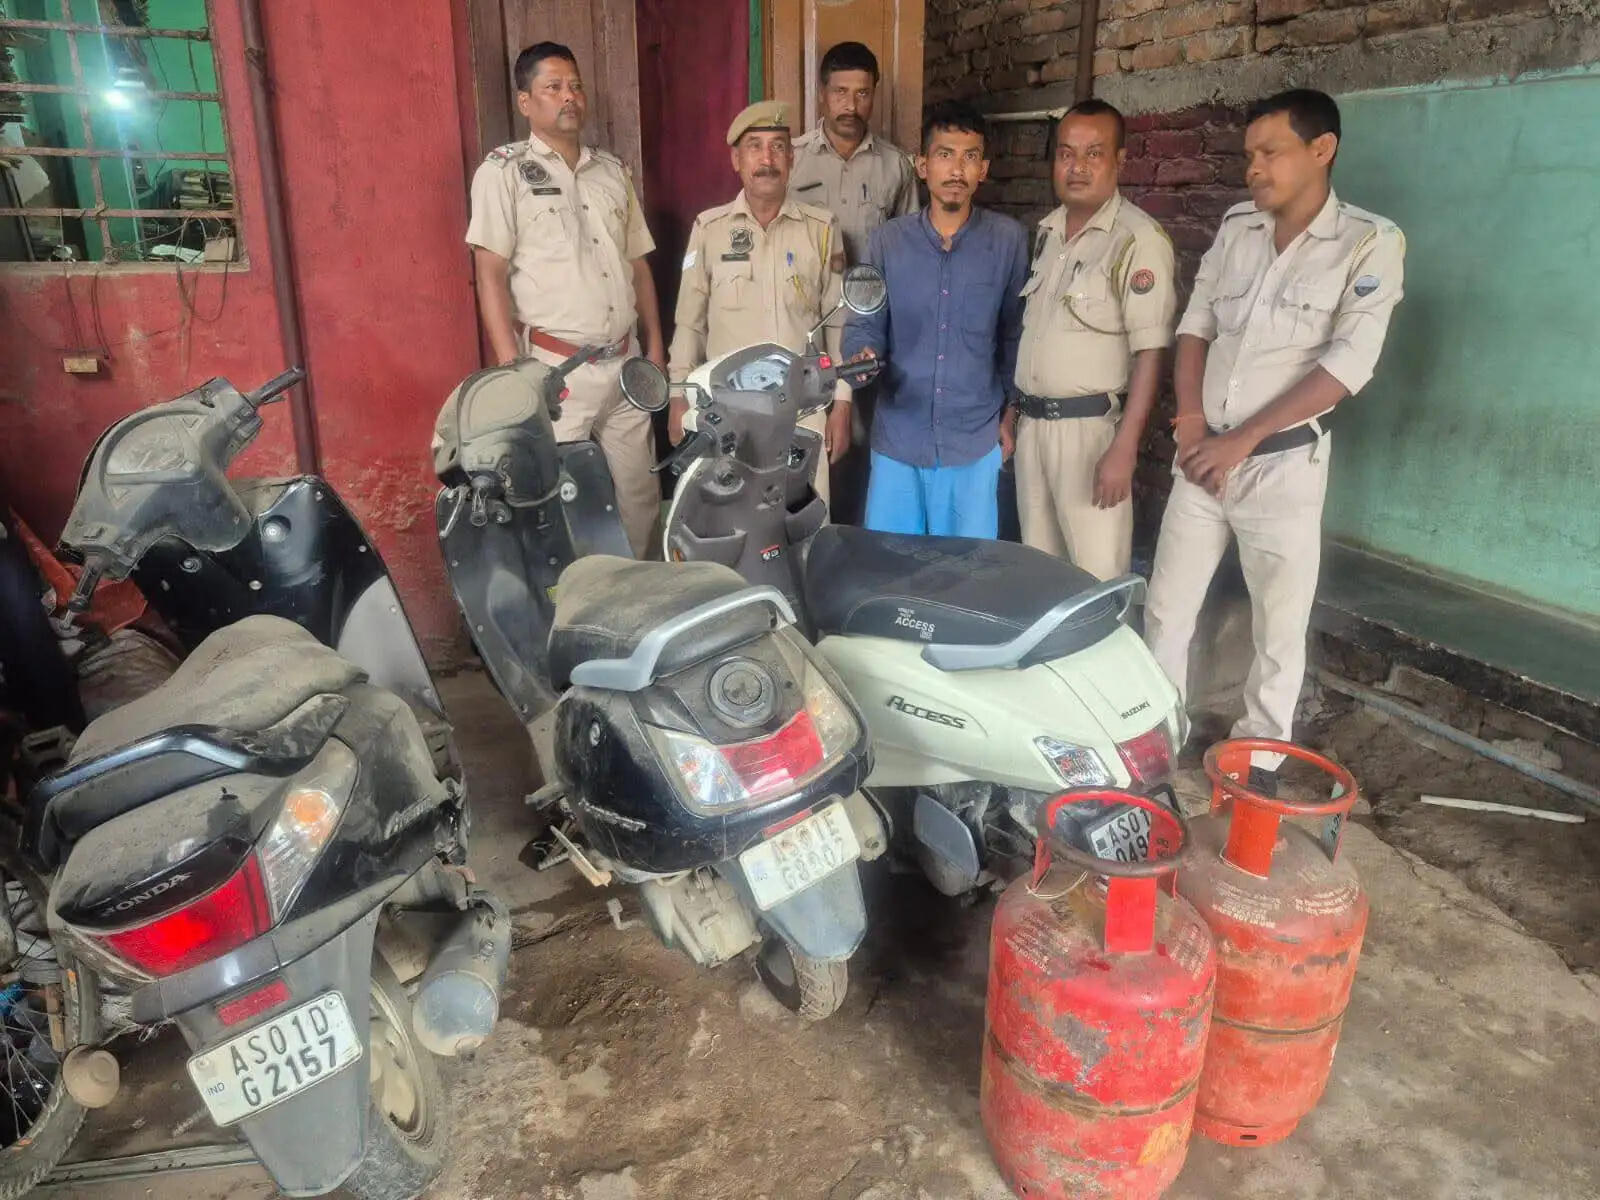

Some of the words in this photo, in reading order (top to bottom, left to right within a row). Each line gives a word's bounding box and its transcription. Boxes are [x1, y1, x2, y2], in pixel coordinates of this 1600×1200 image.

[895, 616, 936, 633] ACCESS
[1120, 700, 1151, 719] SUZUKI
[1115, 831, 1150, 863] 049
[230, 1006, 329, 1076] AS01D
[241, 1035, 337, 1107] G2157
[207, 1081, 225, 1097] IND
